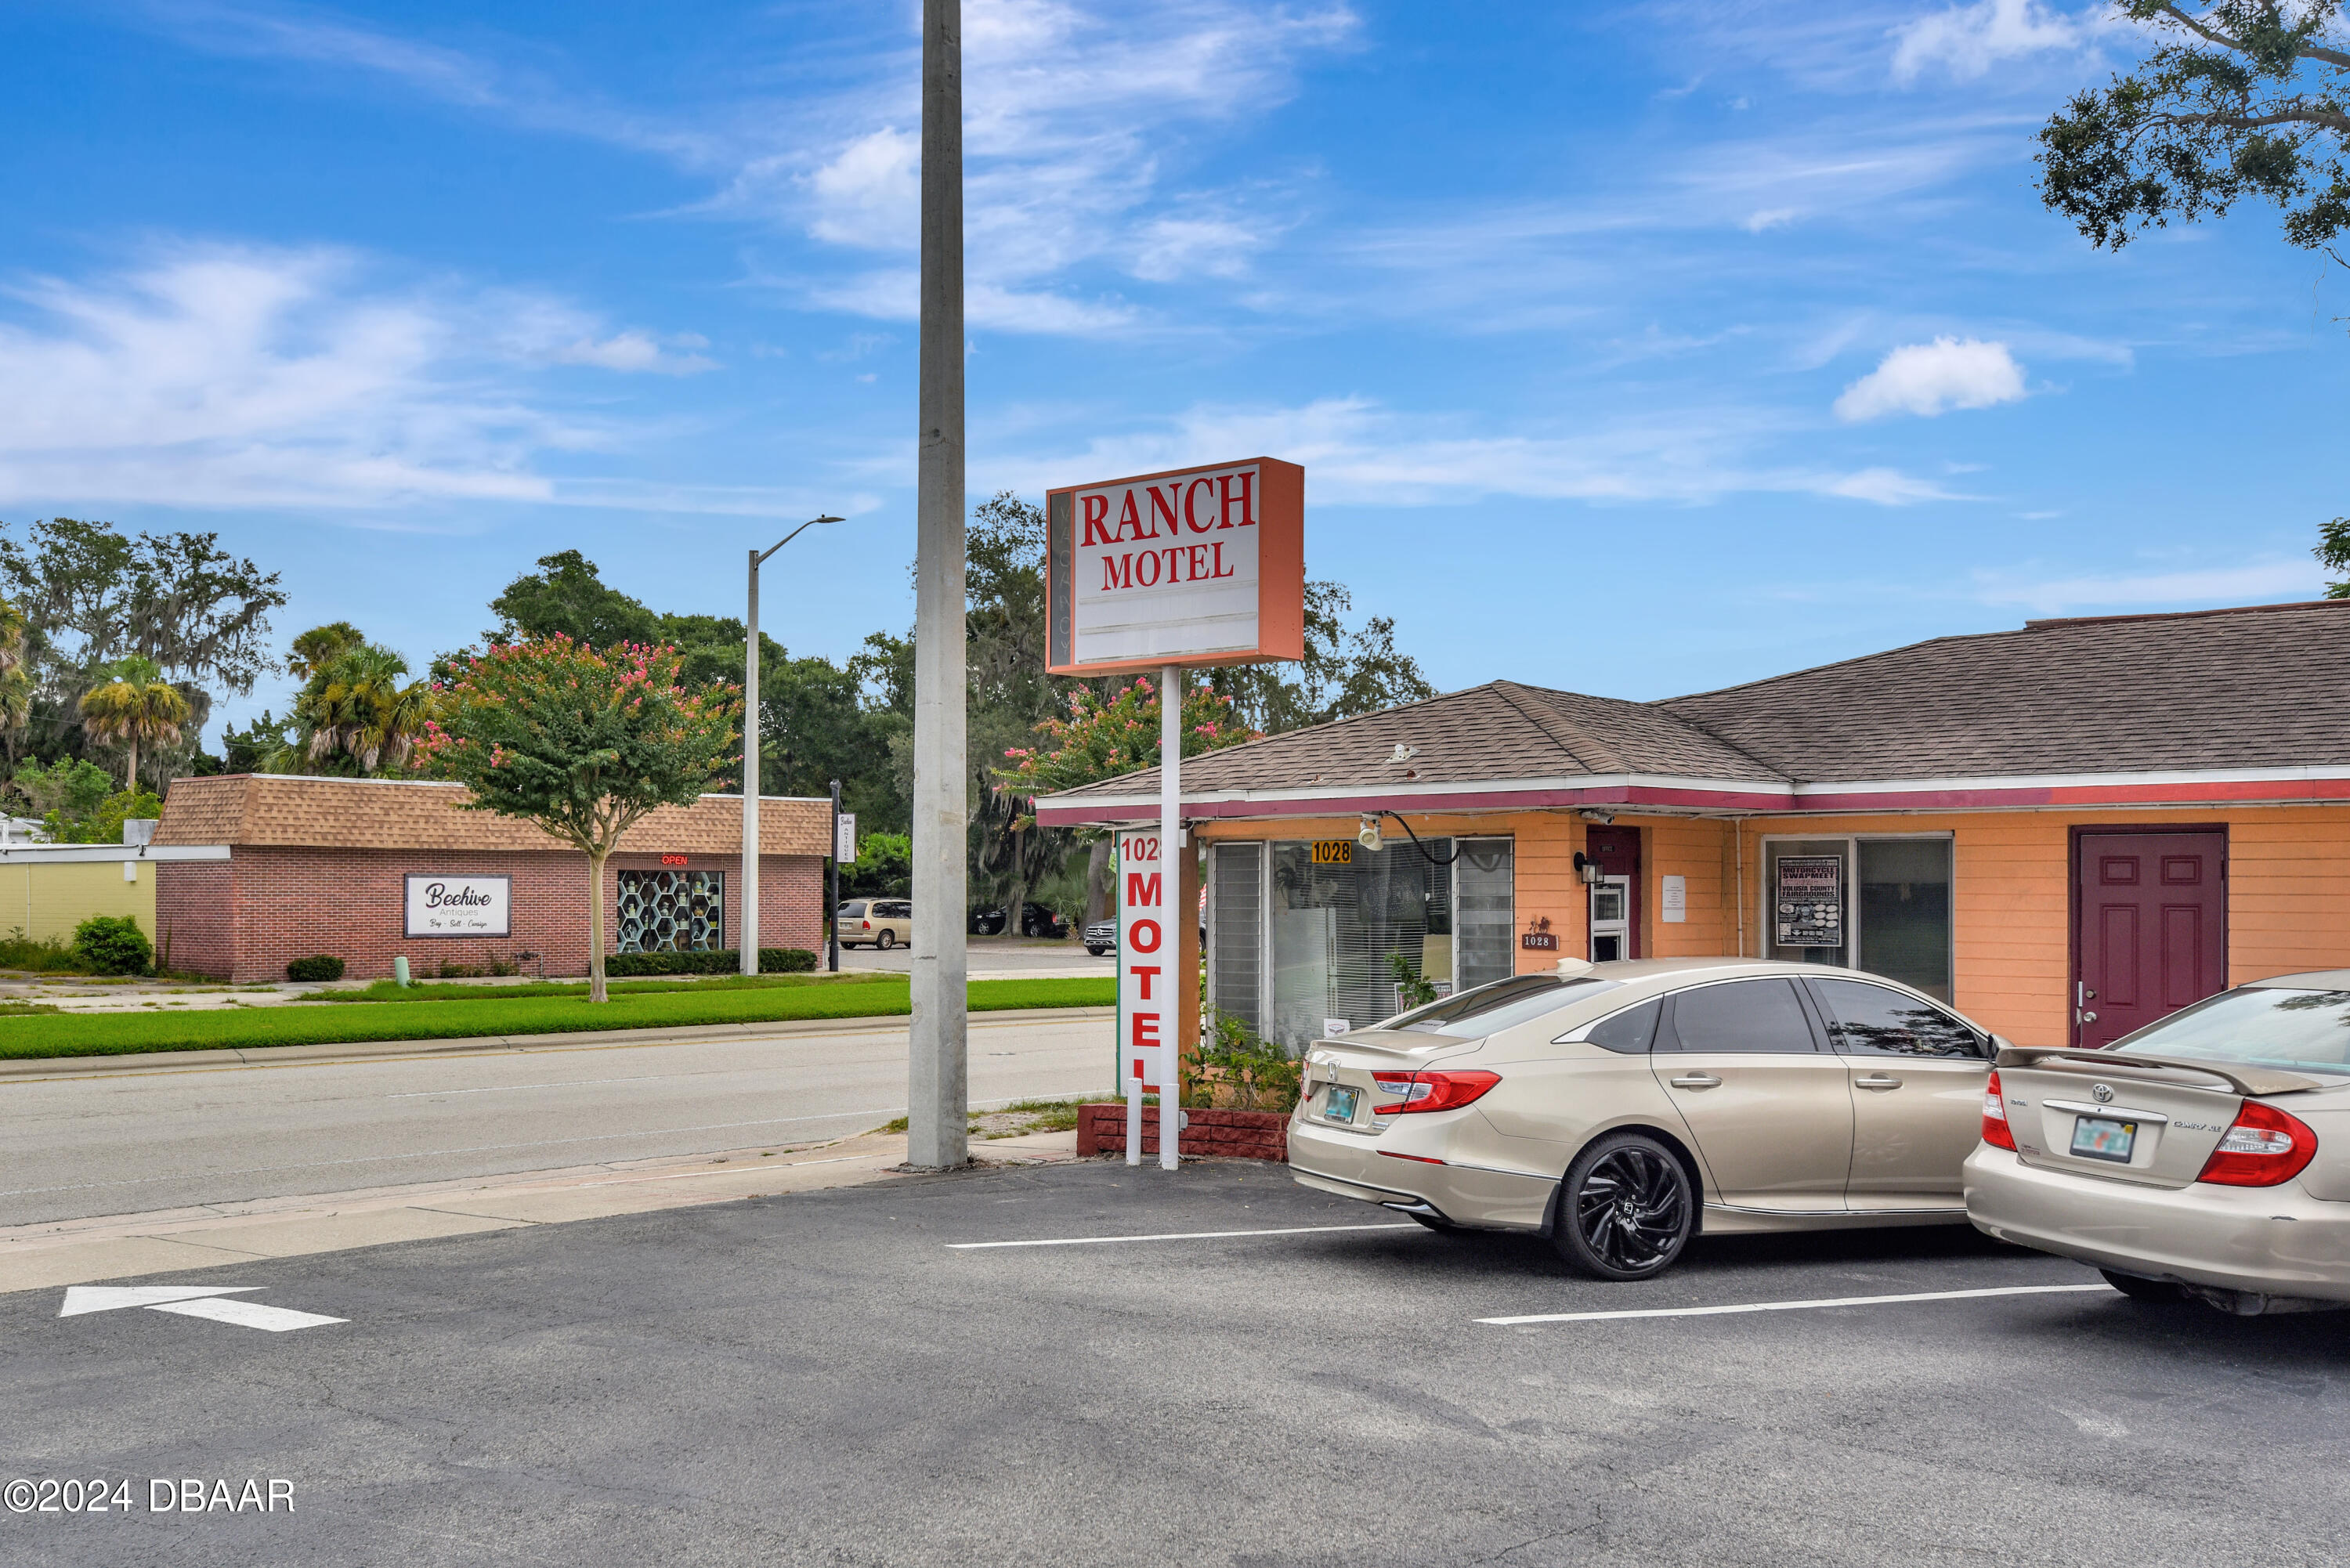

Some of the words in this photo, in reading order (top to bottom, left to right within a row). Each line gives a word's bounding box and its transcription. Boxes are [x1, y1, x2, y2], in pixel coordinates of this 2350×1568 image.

[1080, 471, 1256, 547] RANCH
[1101, 541, 1235, 591] MOTEL
[662, 854, 688, 865] OPEN
[1121, 837, 1162, 862] 102
[1314, 842, 1350, 862] 1028
[425, 883, 492, 909] Beehive
[439, 909, 479, 917] Antiques
[429, 919, 442, 928] Buy
[1524, 937, 1549, 946] 1028
[1127, 872, 1162, 1094] MOTEL
[2173, 1121, 2207, 1130] CAMRY
